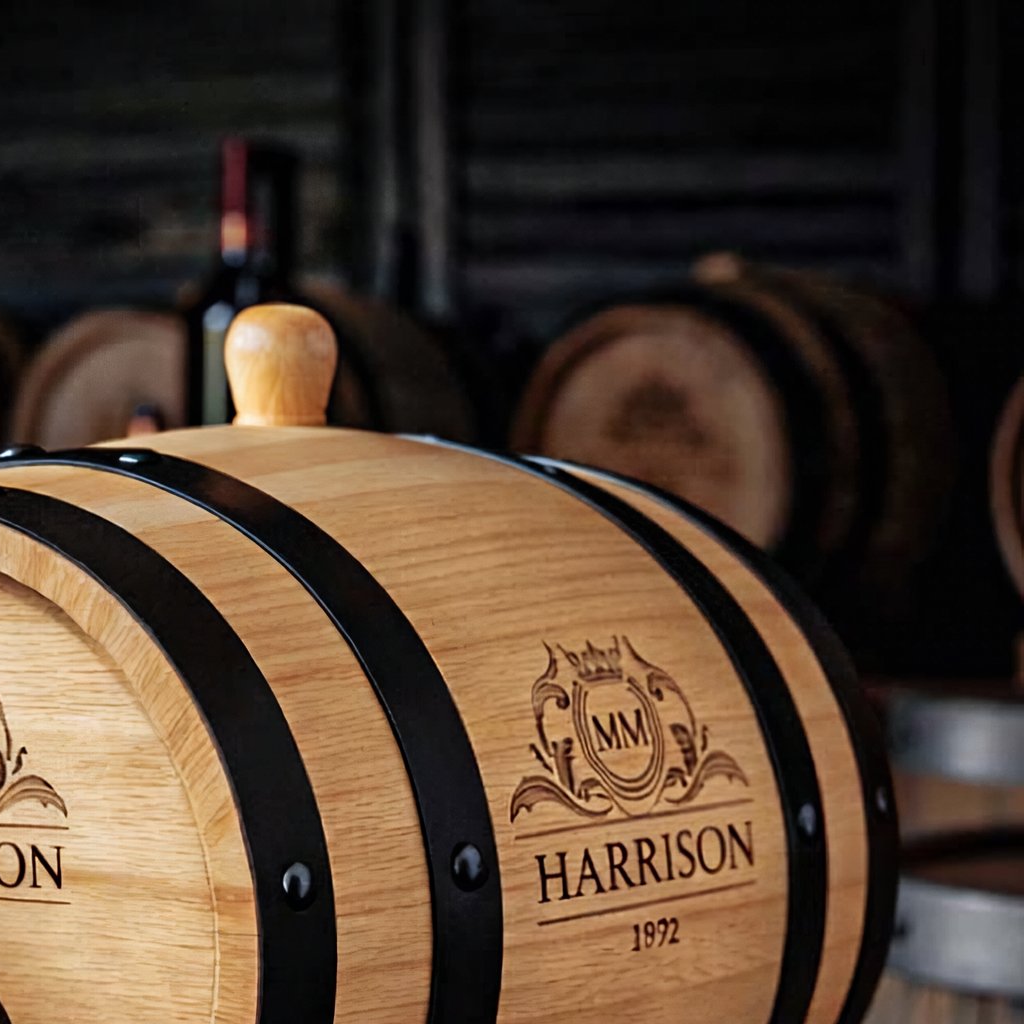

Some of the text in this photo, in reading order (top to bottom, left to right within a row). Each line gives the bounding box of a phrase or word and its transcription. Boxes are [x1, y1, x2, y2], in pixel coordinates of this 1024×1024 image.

[592, 709, 649, 752] MM
[534, 821, 754, 903] HARRISON
[631, 917, 680, 951] 1892
